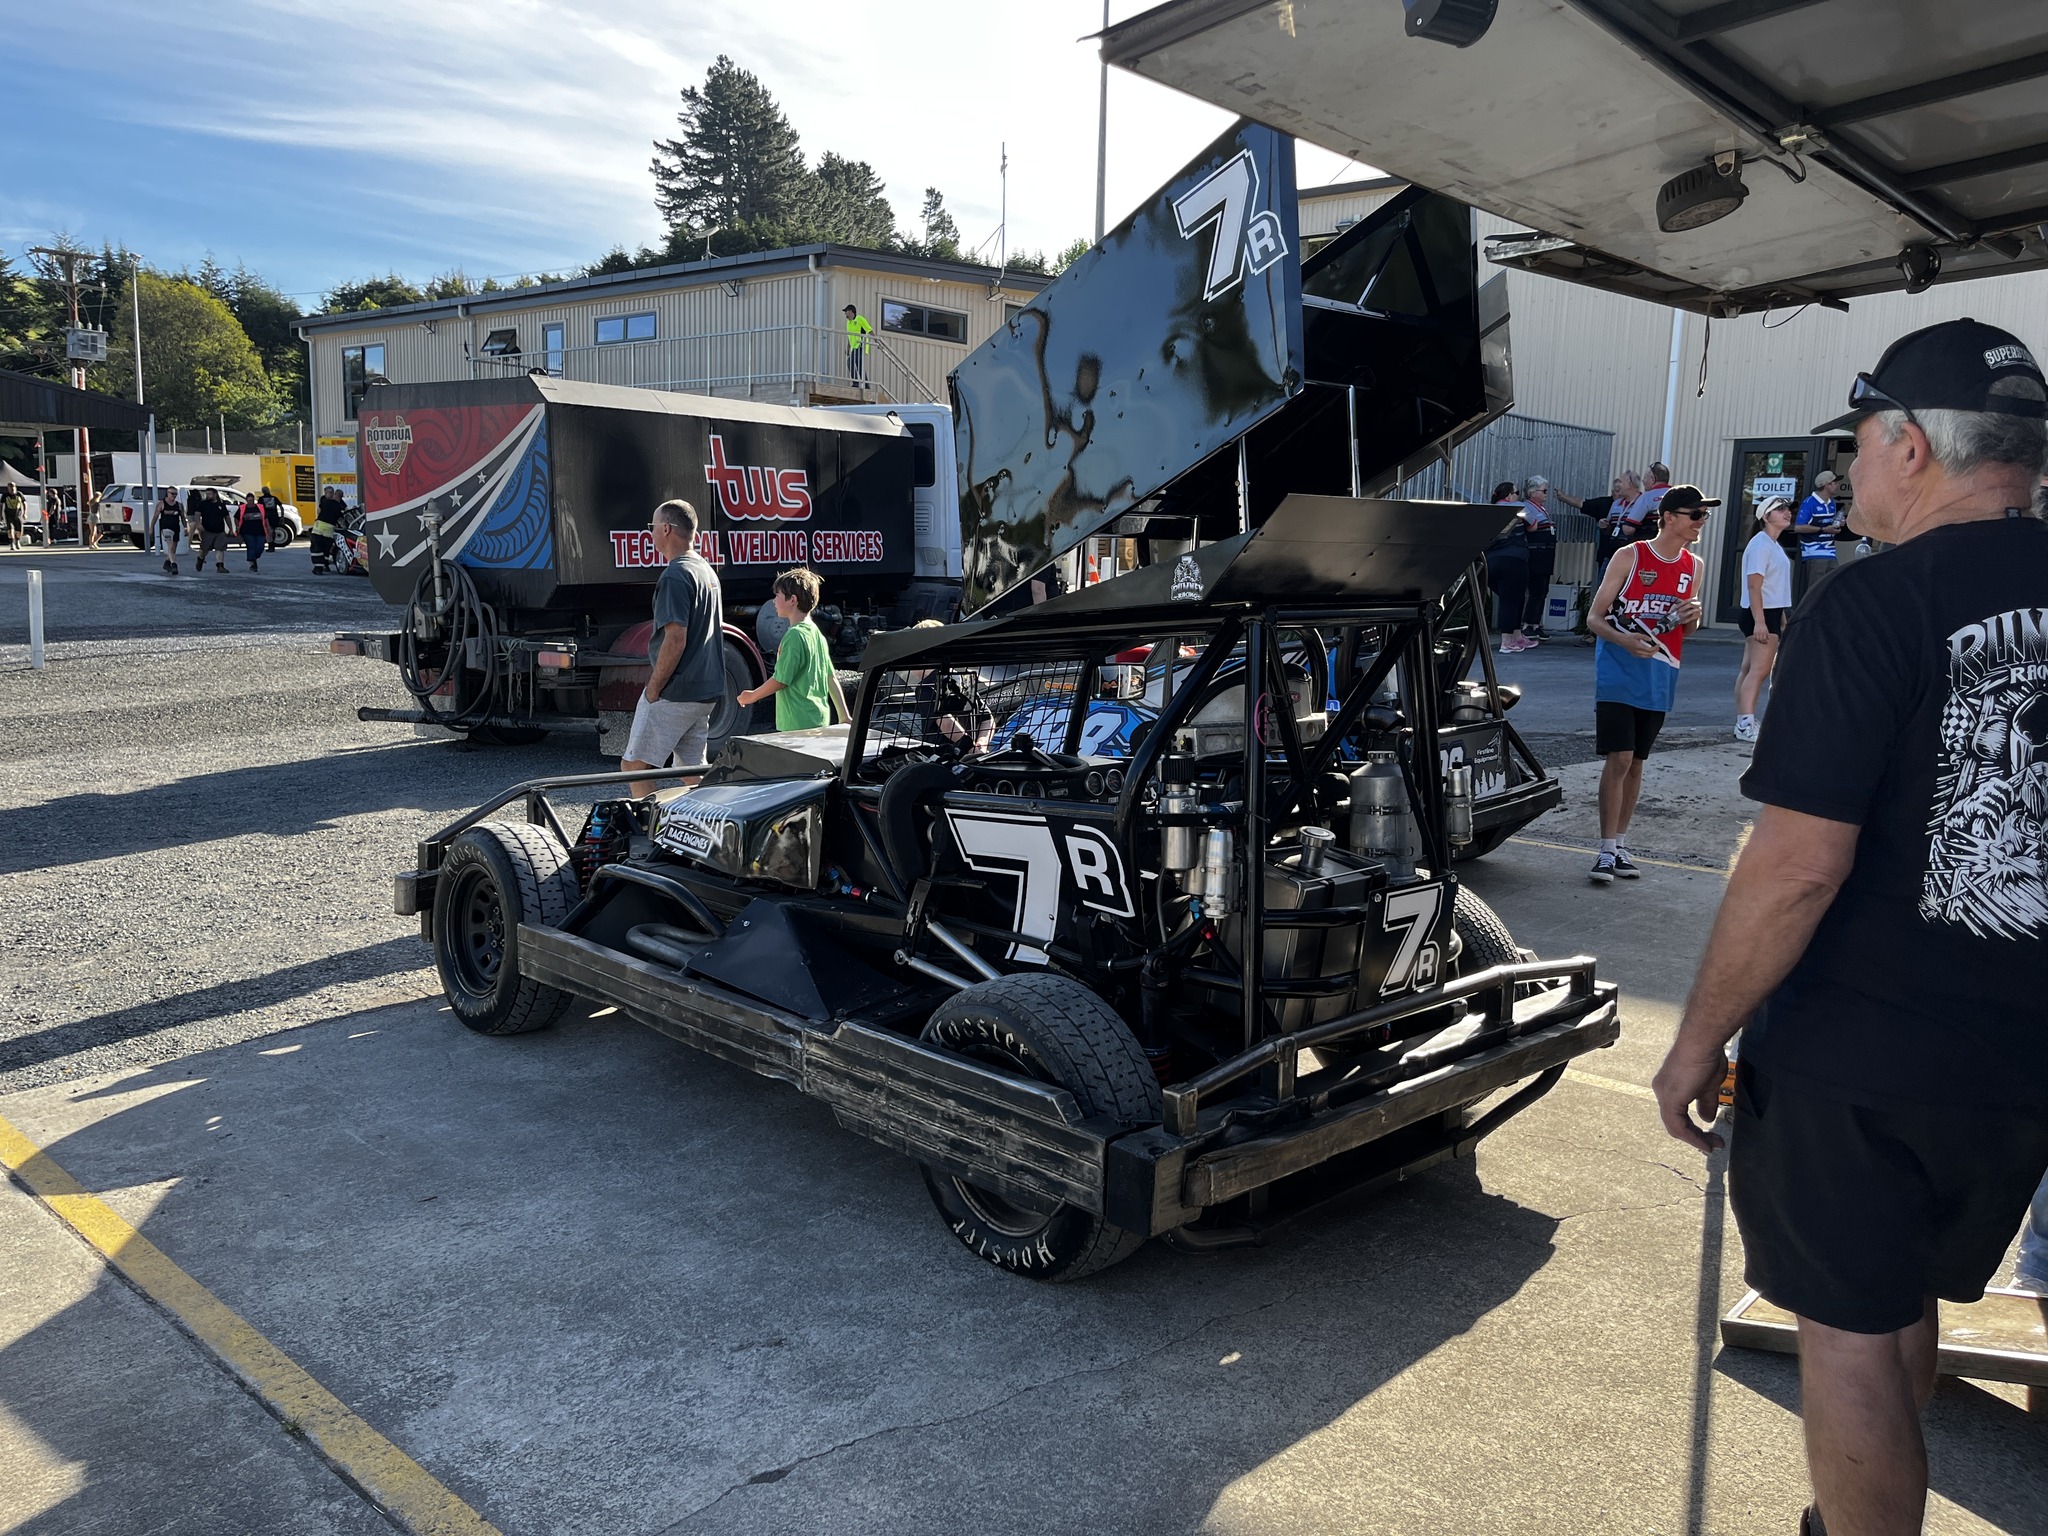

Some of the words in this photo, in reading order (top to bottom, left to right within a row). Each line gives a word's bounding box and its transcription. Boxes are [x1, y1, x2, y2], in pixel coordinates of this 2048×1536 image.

[367, 428, 411, 442] ROTORUA
[384, 451, 395, 459] CLUB
[489, 505, 501, 519] and
[499, 482, 516, 503] direct
[515, 426, 545, 479] movements
[704, 435, 812, 521] tws
[1756, 482, 1793, 492] TOILET
[729, 530, 807, 564] WELDING
[812, 530, 884, 563] SERVICES
[1677, 573, 1692, 594] 5
[1643, 593, 1680, 602] ROTORU
[1476, 747, 1495, 756] Firstline
[1474, 754, 1499, 764] Equipment
[667, 826, 685, 842] RACE
[682, 832, 709, 850] ENGINES
